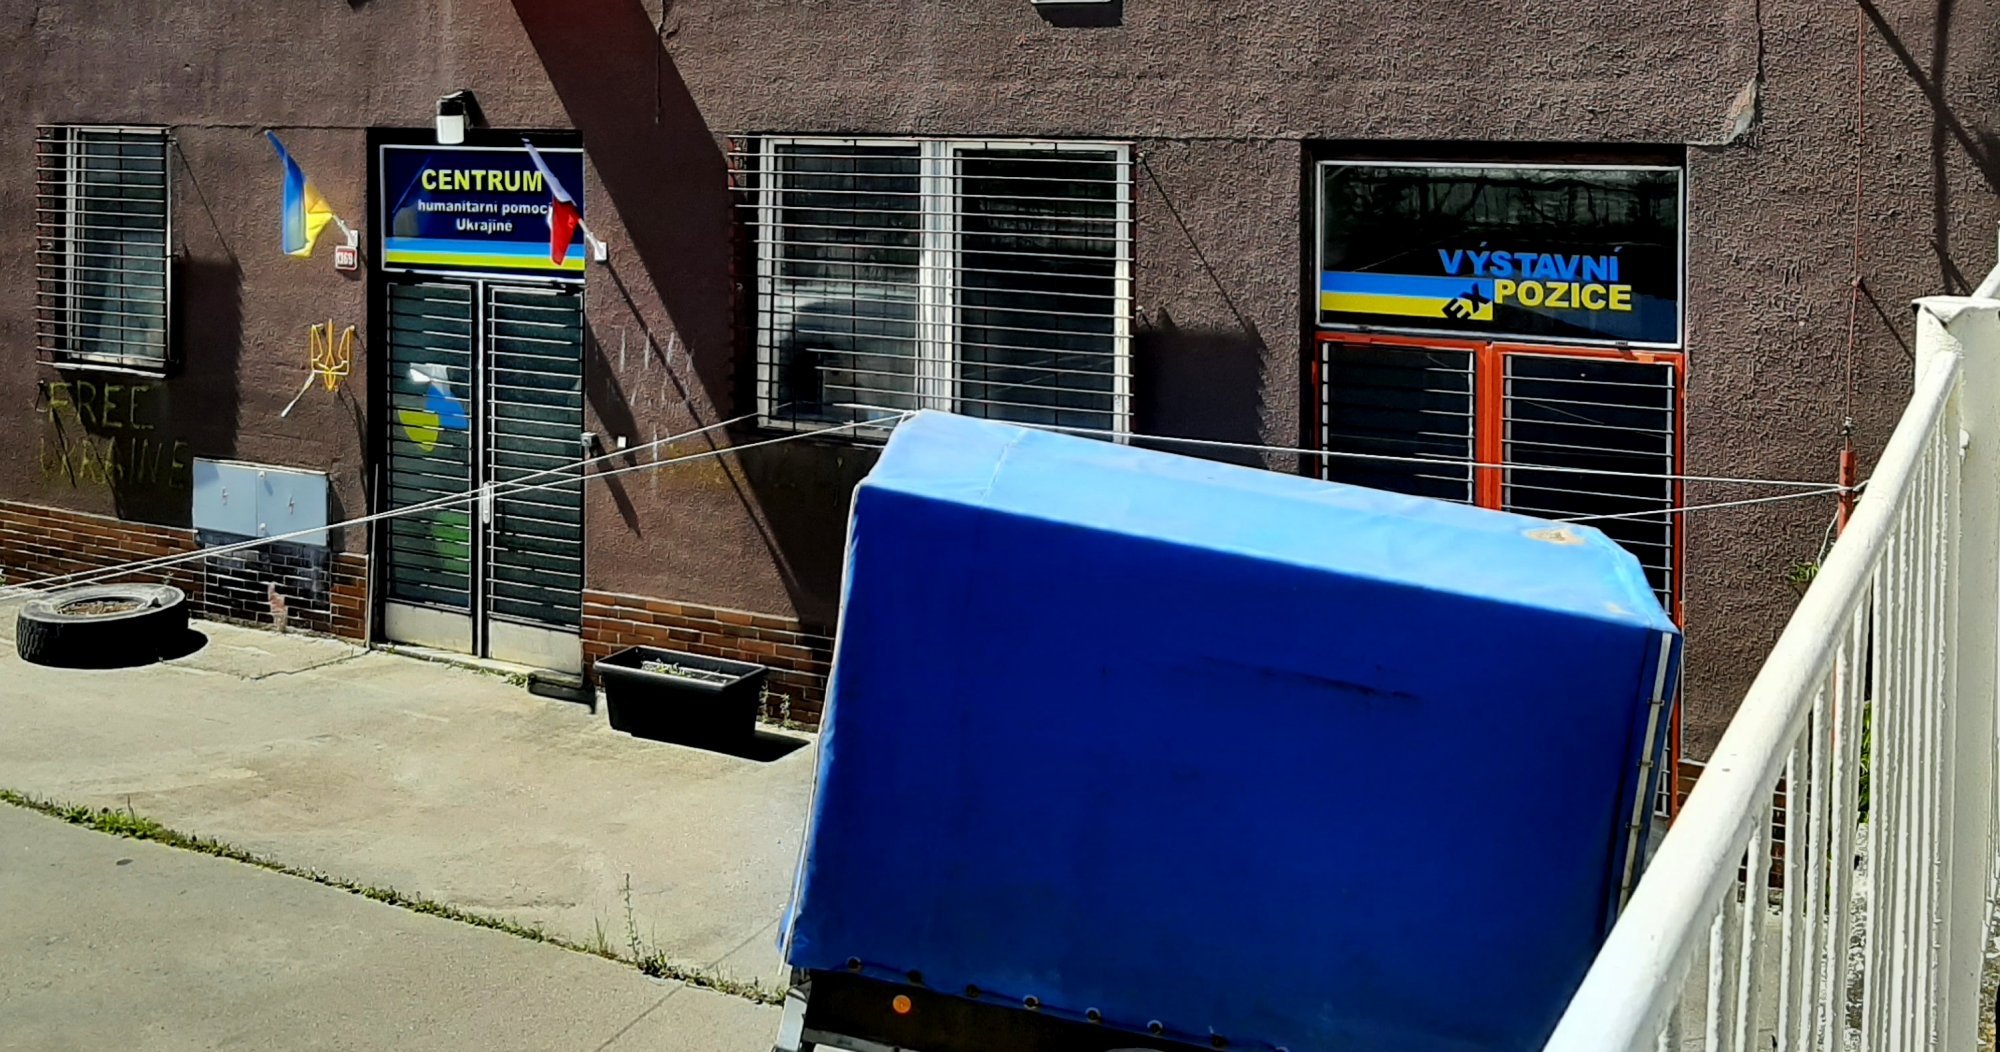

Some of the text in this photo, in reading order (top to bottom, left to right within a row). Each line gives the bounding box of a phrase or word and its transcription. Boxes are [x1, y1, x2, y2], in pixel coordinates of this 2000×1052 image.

[421, 169, 543, 192] CENTRUM
[1438, 241, 1623, 282] VÝSTAVNÍ
[1495, 278, 1632, 311] POZICE
[49, 380, 155, 430] FREE
